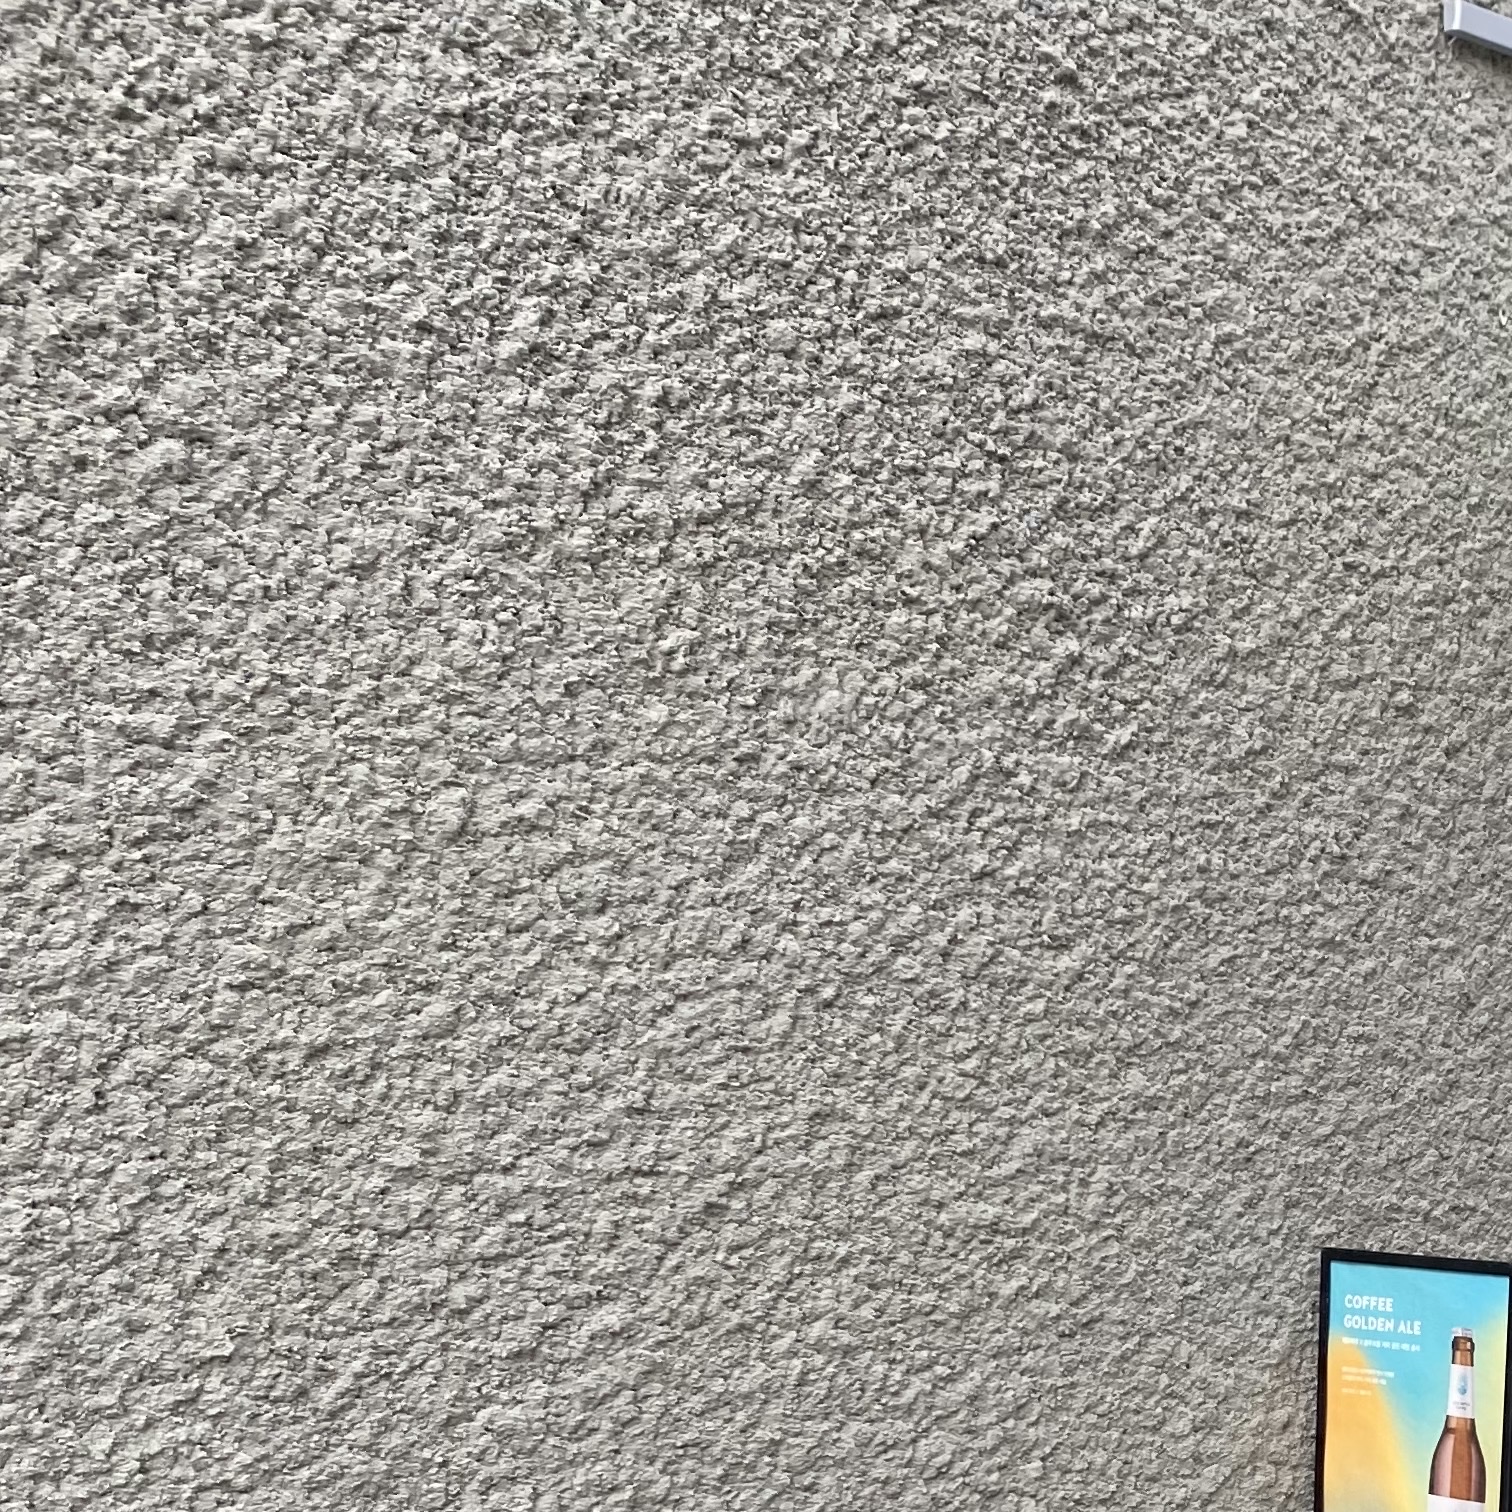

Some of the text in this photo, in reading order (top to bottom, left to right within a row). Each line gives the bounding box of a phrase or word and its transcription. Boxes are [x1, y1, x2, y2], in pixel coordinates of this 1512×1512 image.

[1344, 1294, 1394, 1313] COFFEE
[1343, 1313, 1422, 1336] GOLDEN ALE
